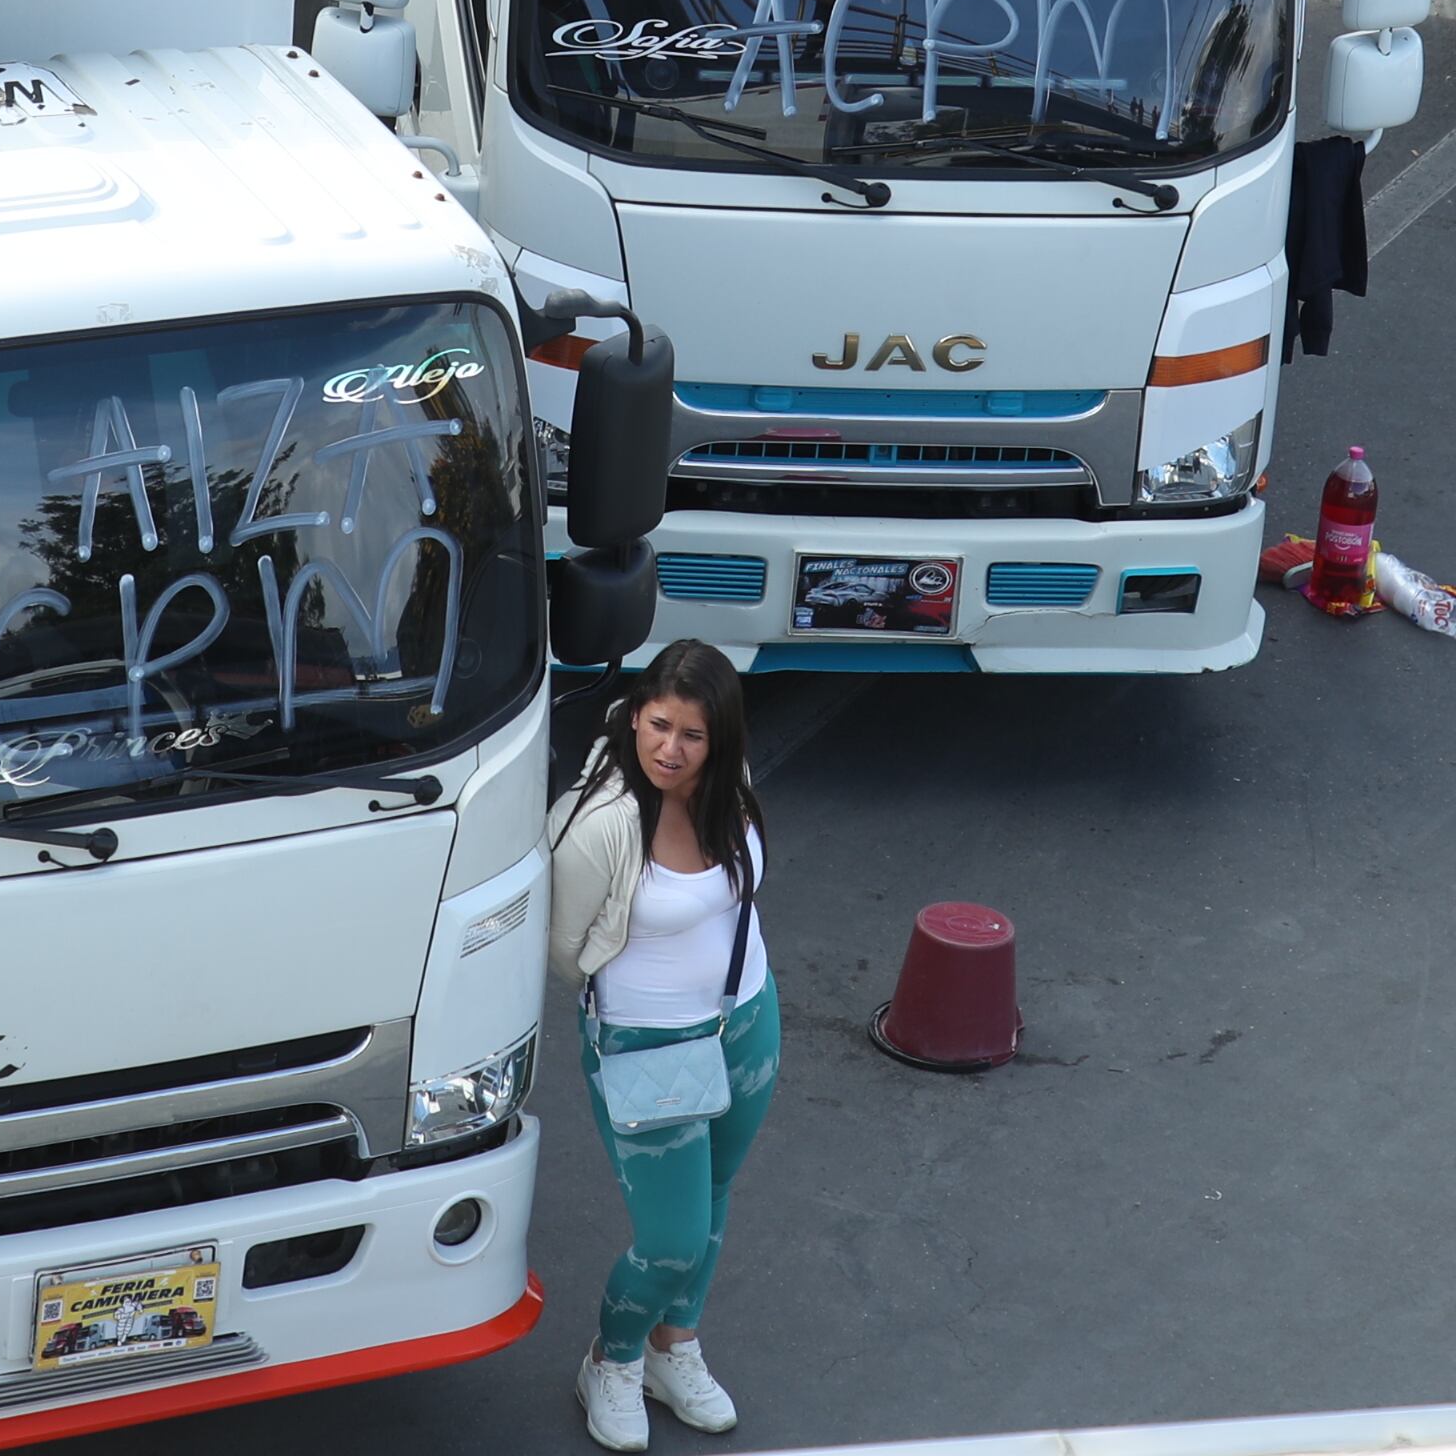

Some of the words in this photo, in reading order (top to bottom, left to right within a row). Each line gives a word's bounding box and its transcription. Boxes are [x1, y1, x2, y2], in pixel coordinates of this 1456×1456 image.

[545, 19, 747, 60] Sofia
[812, 333, 988, 372] JAC
[323, 348, 484, 404] Alejo
[805, 559, 856, 572] FINALES
[834, 565, 906, 576] NACIONALES
[100, 1278, 155, 1296] FERIA
